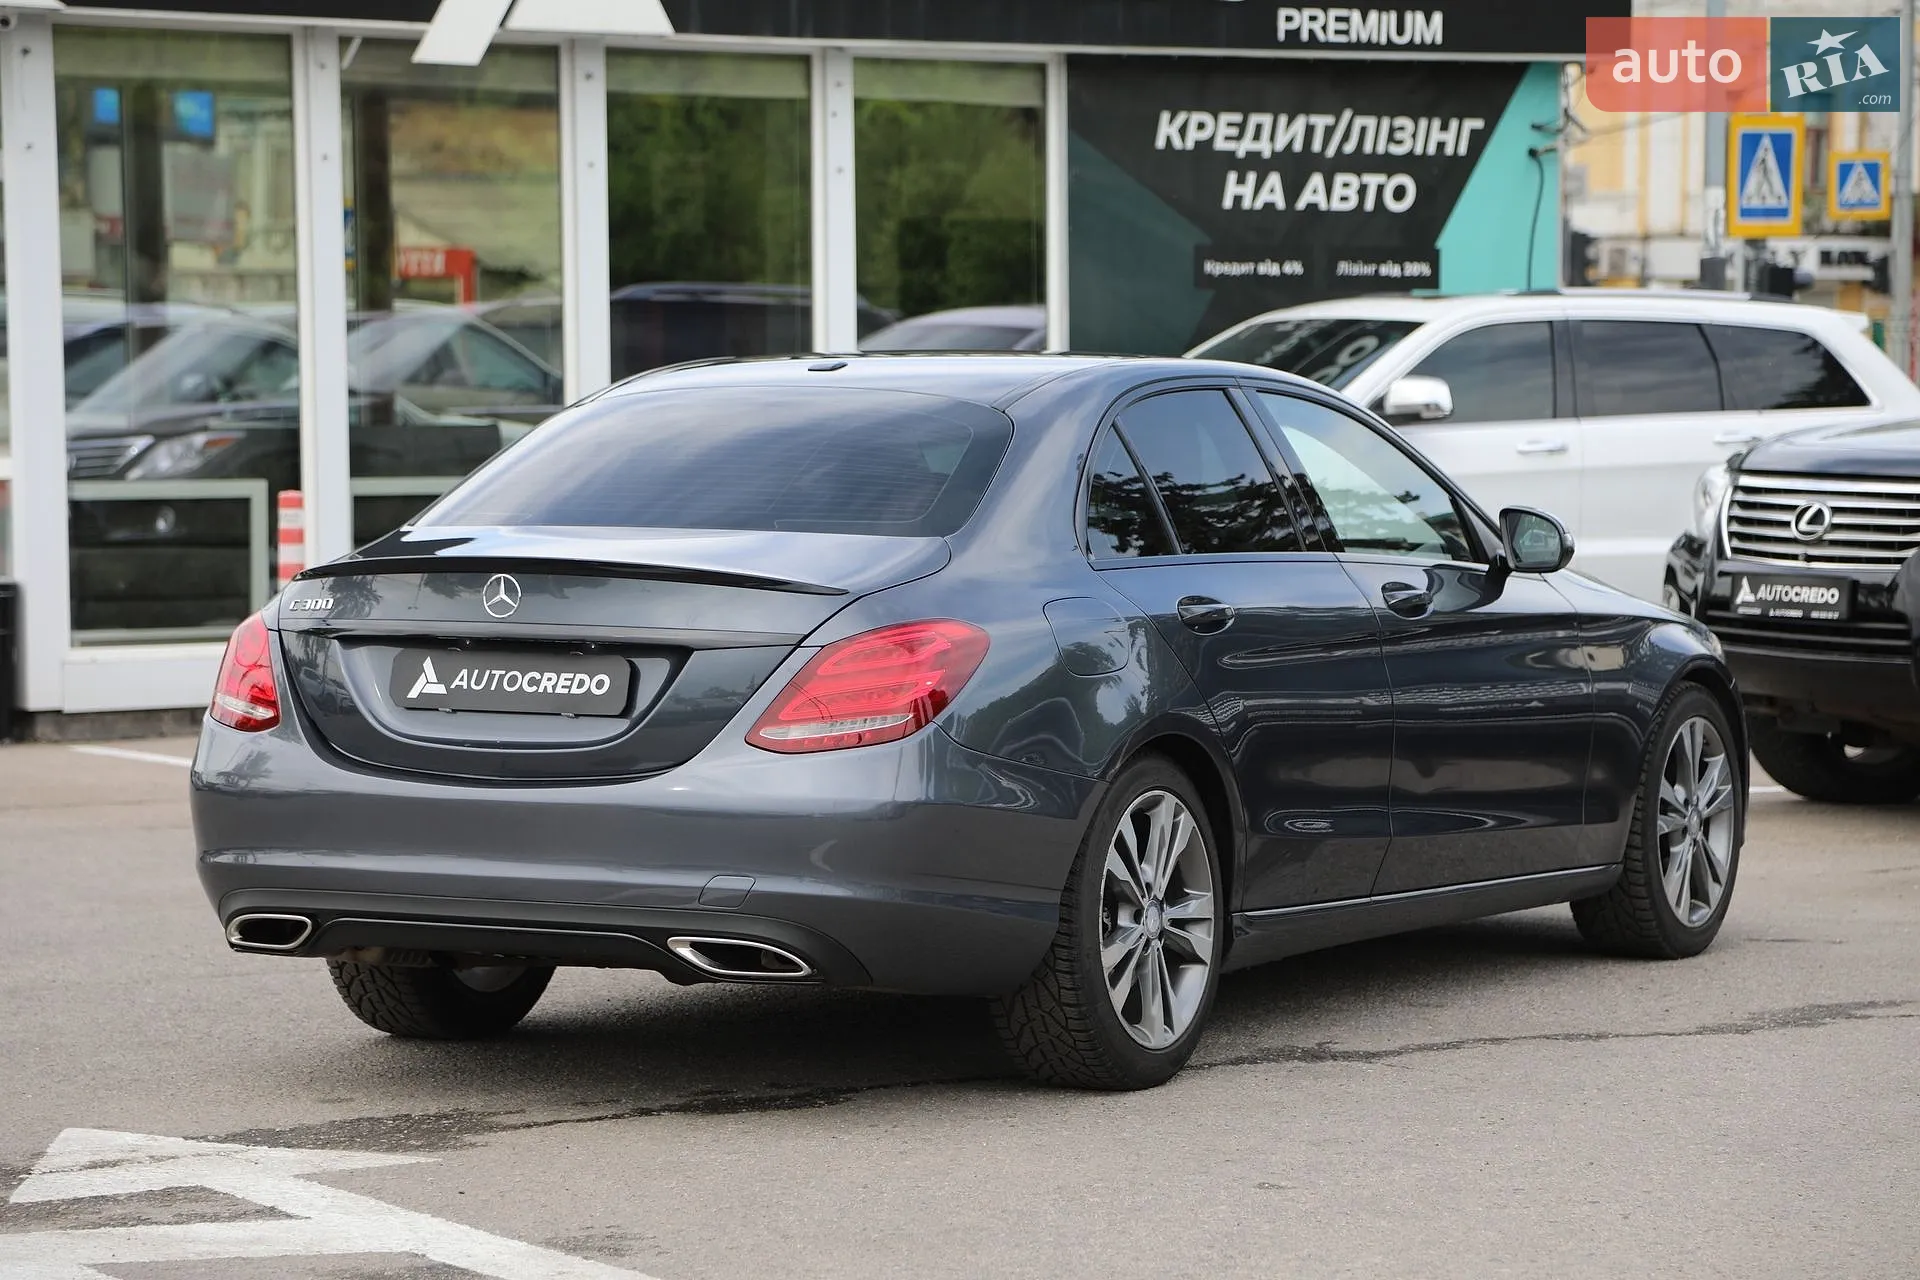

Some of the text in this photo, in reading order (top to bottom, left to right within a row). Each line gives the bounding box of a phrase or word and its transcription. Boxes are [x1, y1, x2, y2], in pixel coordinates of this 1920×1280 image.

[1277, 7, 1443, 46] PREMIUM
[1154, 108, 1485, 159] КРЕДИТ/ЛІЗІНГ
[1221, 170, 1417, 213] НА АВТО
[1203, 259, 1255, 277] Кредит
[1756, 583, 1840, 605] AUTOCREDO
[449, 668, 611, 696] AUTOCREDO
